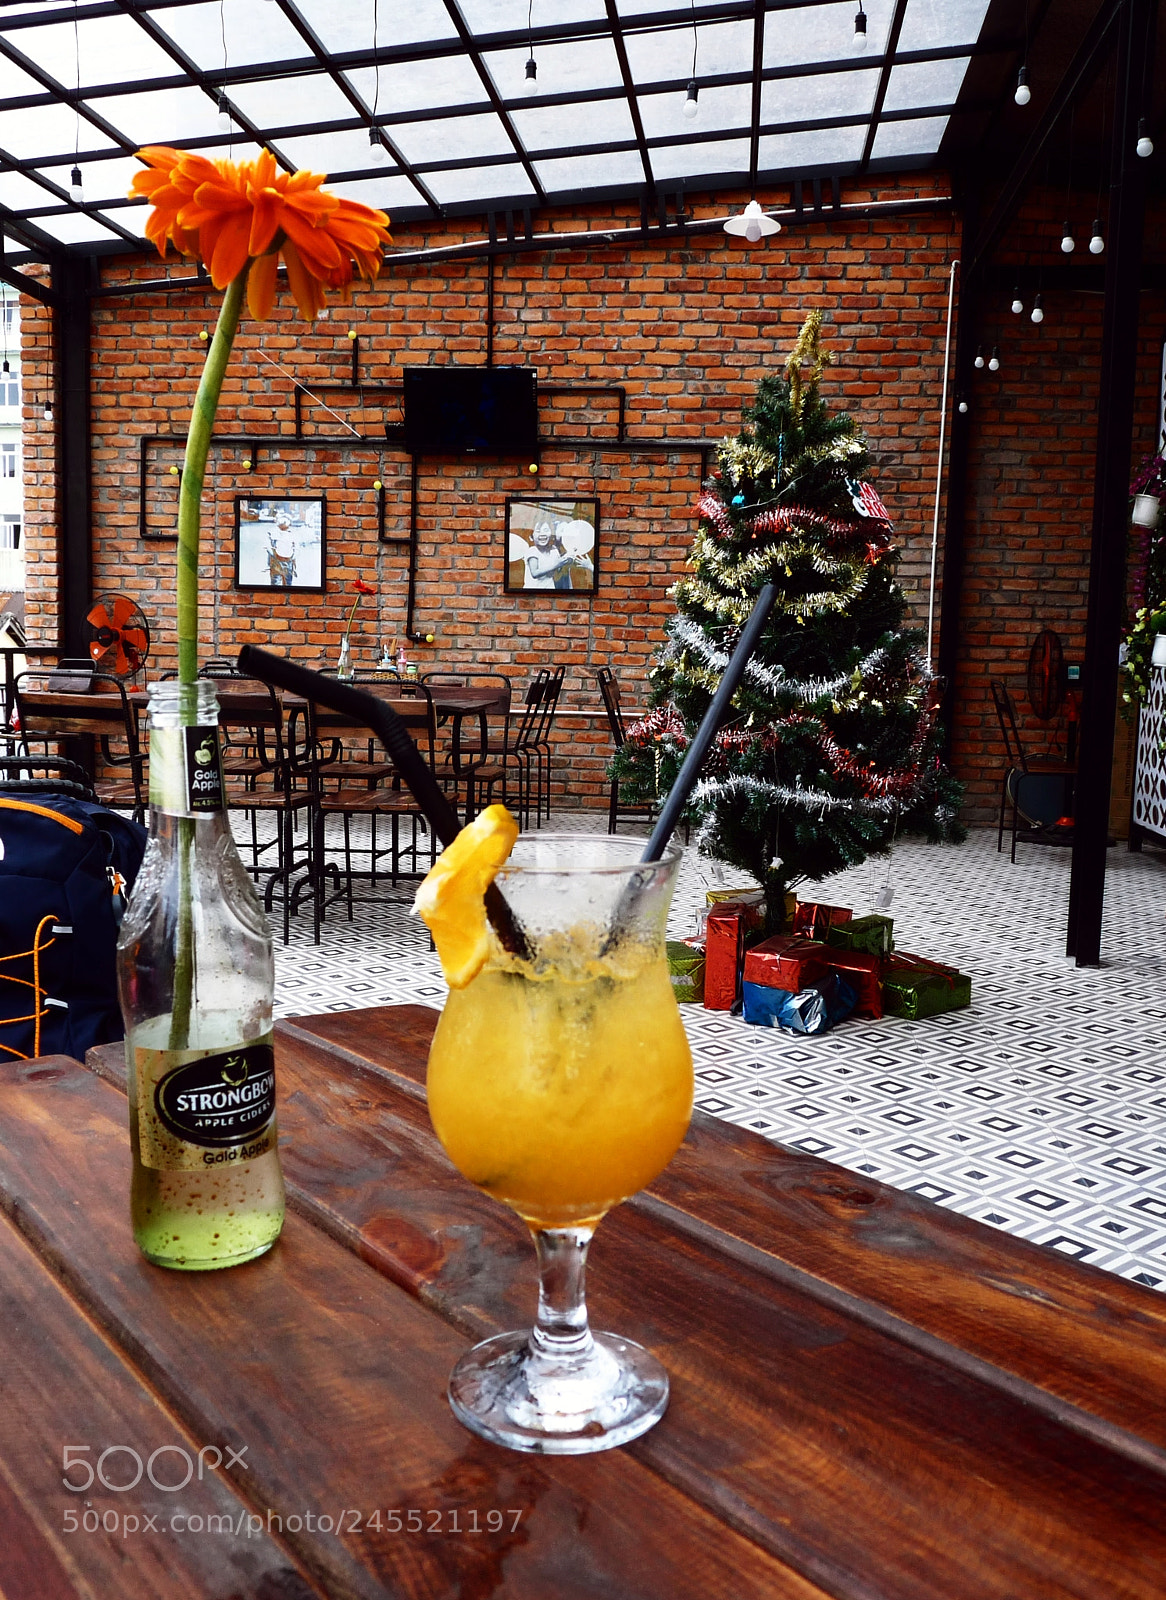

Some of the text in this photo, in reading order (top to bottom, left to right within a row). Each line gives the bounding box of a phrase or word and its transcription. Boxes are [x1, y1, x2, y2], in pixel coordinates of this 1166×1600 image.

[194, 769, 217, 780] Gold
[191, 779, 220, 791] Apple
[194, 1116, 235, 1128] APPLE
[202, 1137, 270, 1165] Gold Apple
